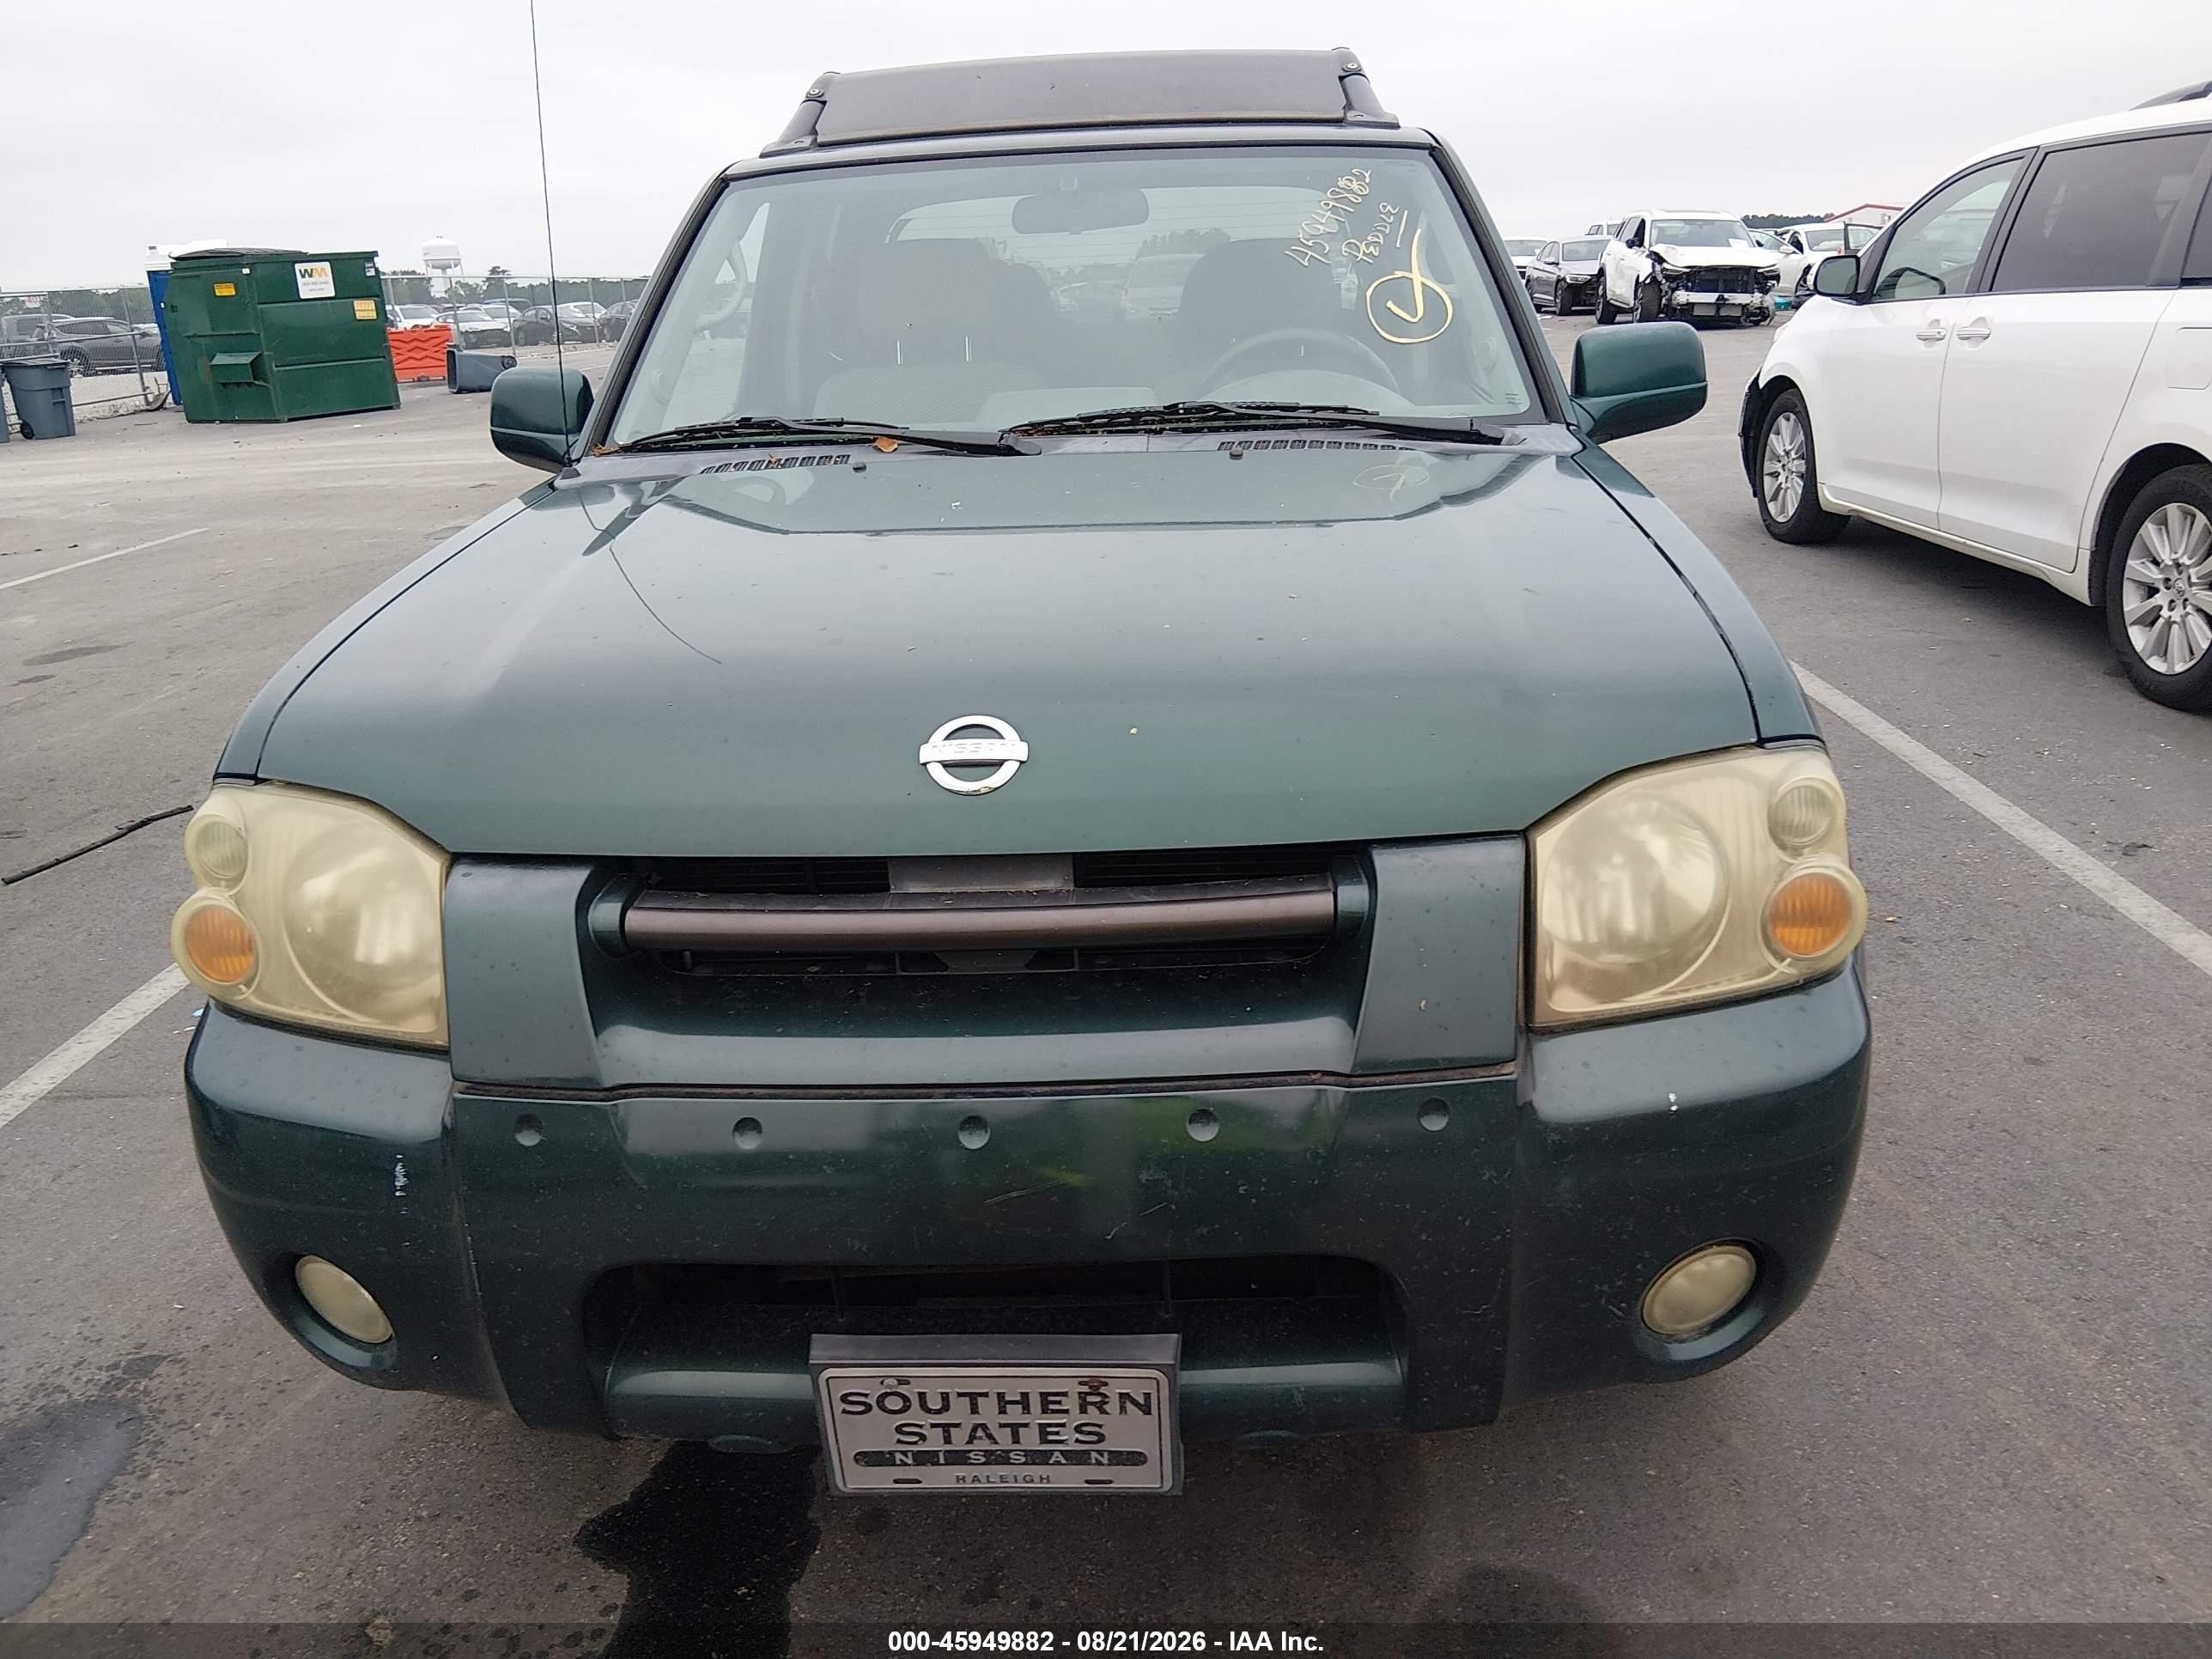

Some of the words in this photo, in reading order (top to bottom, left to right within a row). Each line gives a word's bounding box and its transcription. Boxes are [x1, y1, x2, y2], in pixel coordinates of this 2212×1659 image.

[299, 267, 328, 278] WM
[839, 1391, 1153, 1416] SOUTHERN
[894, 1422, 1106, 1446] STATES
[896, 1451, 1110, 1465] NISSAN
[956, 1474, 1052, 1485] RALEIGH
